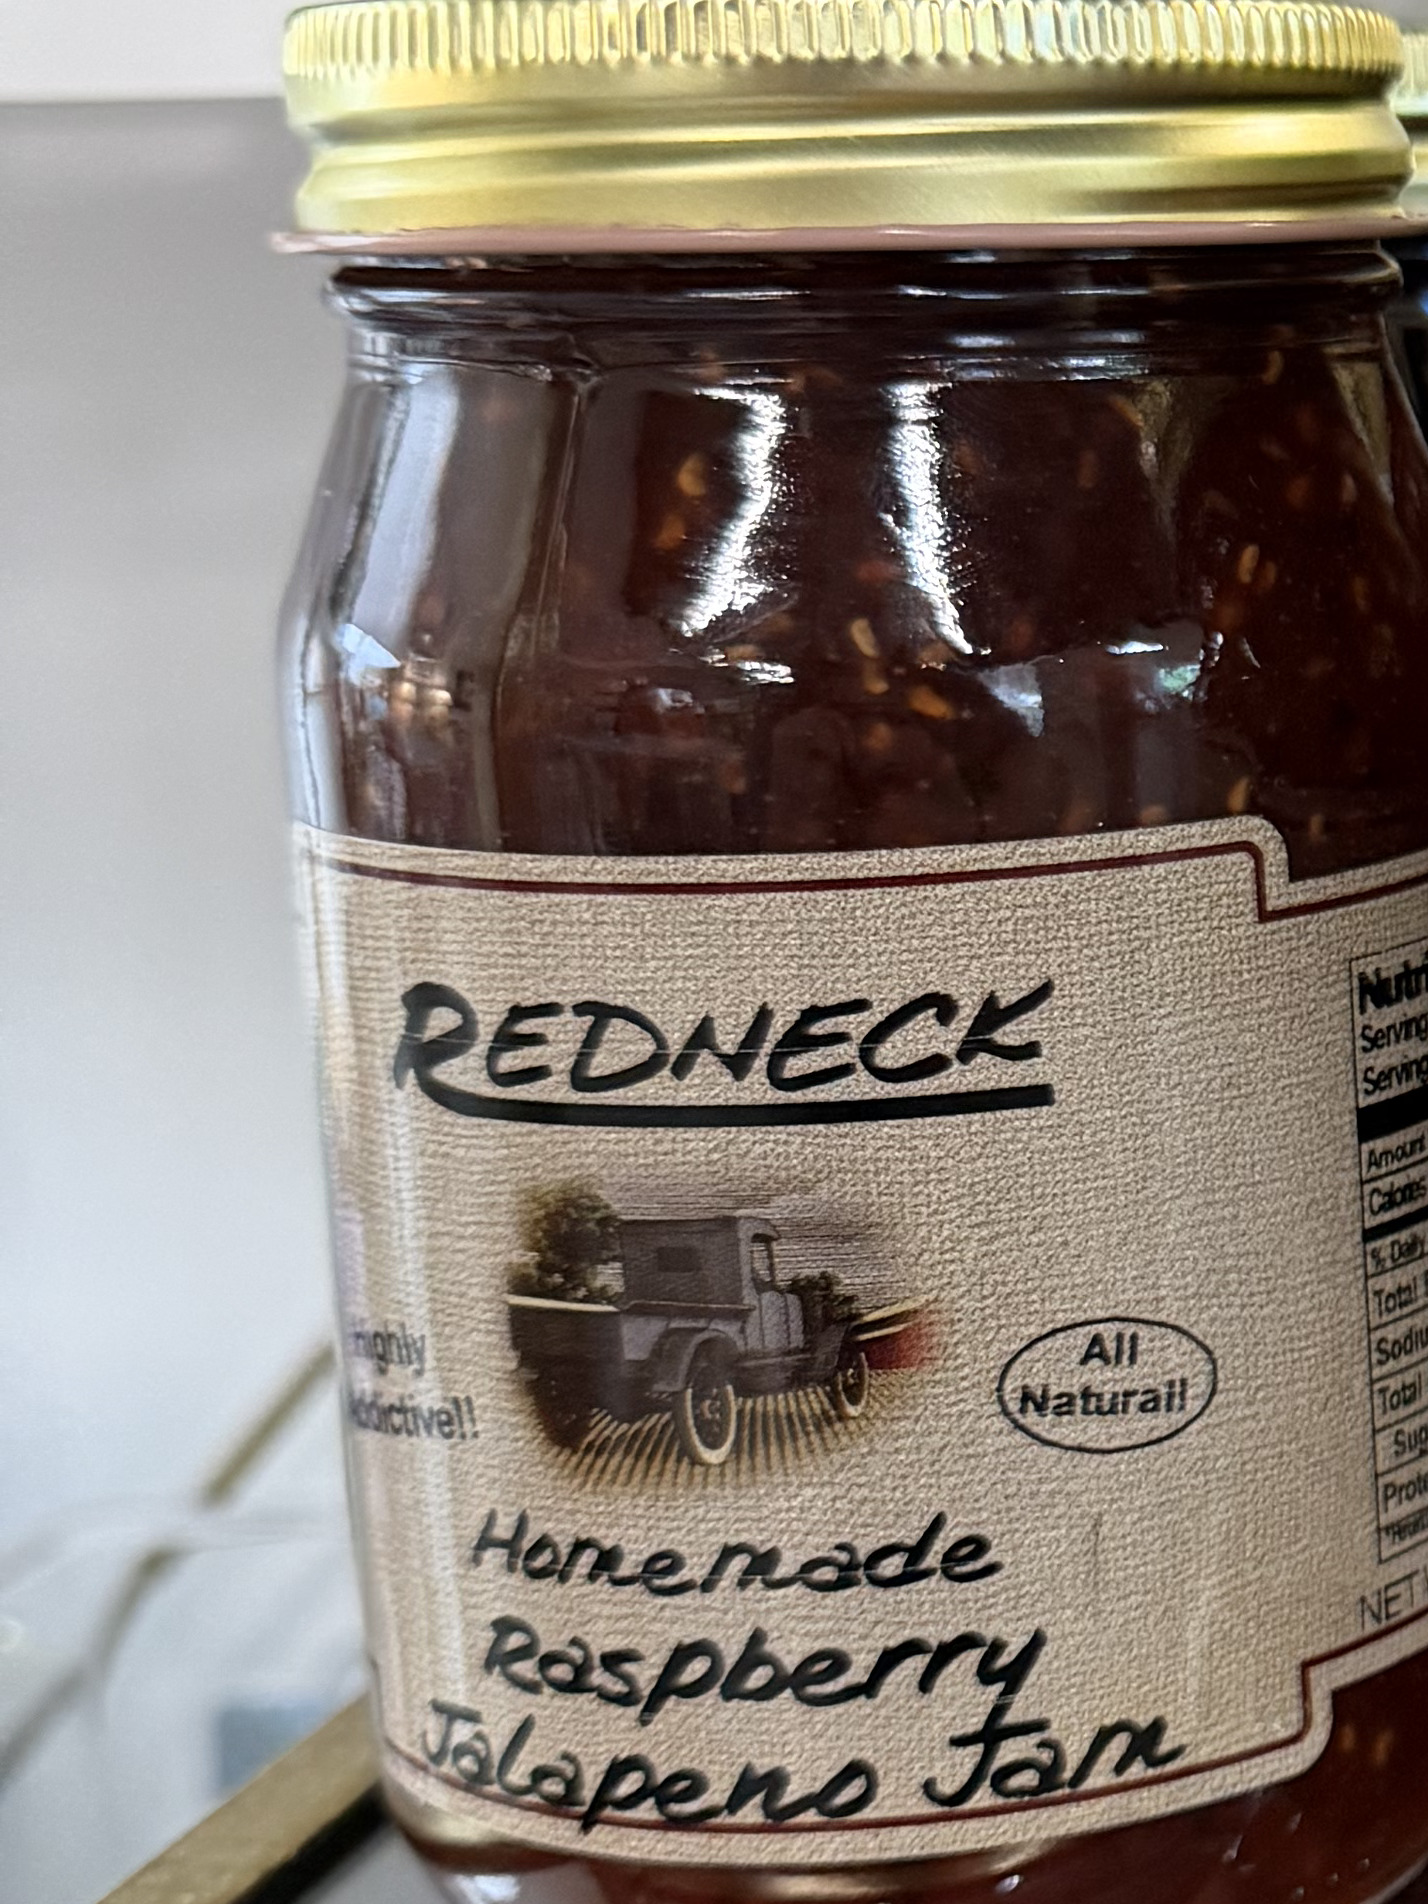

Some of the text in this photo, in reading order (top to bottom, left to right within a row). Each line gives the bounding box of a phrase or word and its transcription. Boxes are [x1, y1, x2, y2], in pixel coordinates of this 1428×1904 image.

[393, 980, 1055, 1127] REDNECK
[1361, 1011, 1428, 1053] Serving
[1366, 1133, 1426, 1174] Amount
[1369, 1176, 1428, 1216] Calories
[1373, 1276, 1418, 1319] Total
[1080, 1332, 1138, 1367] All
[1019, 1377, 1188, 1418] Natural!
[1377, 1371, 1422, 1416] Total
[473, 1508, 1004, 1595] Homemade
[1358, 1569, 1420, 1631] NET
[483, 1616, 1048, 1726] Raspberry
[421, 1698, 1186, 1836] Jalapeno Jam
